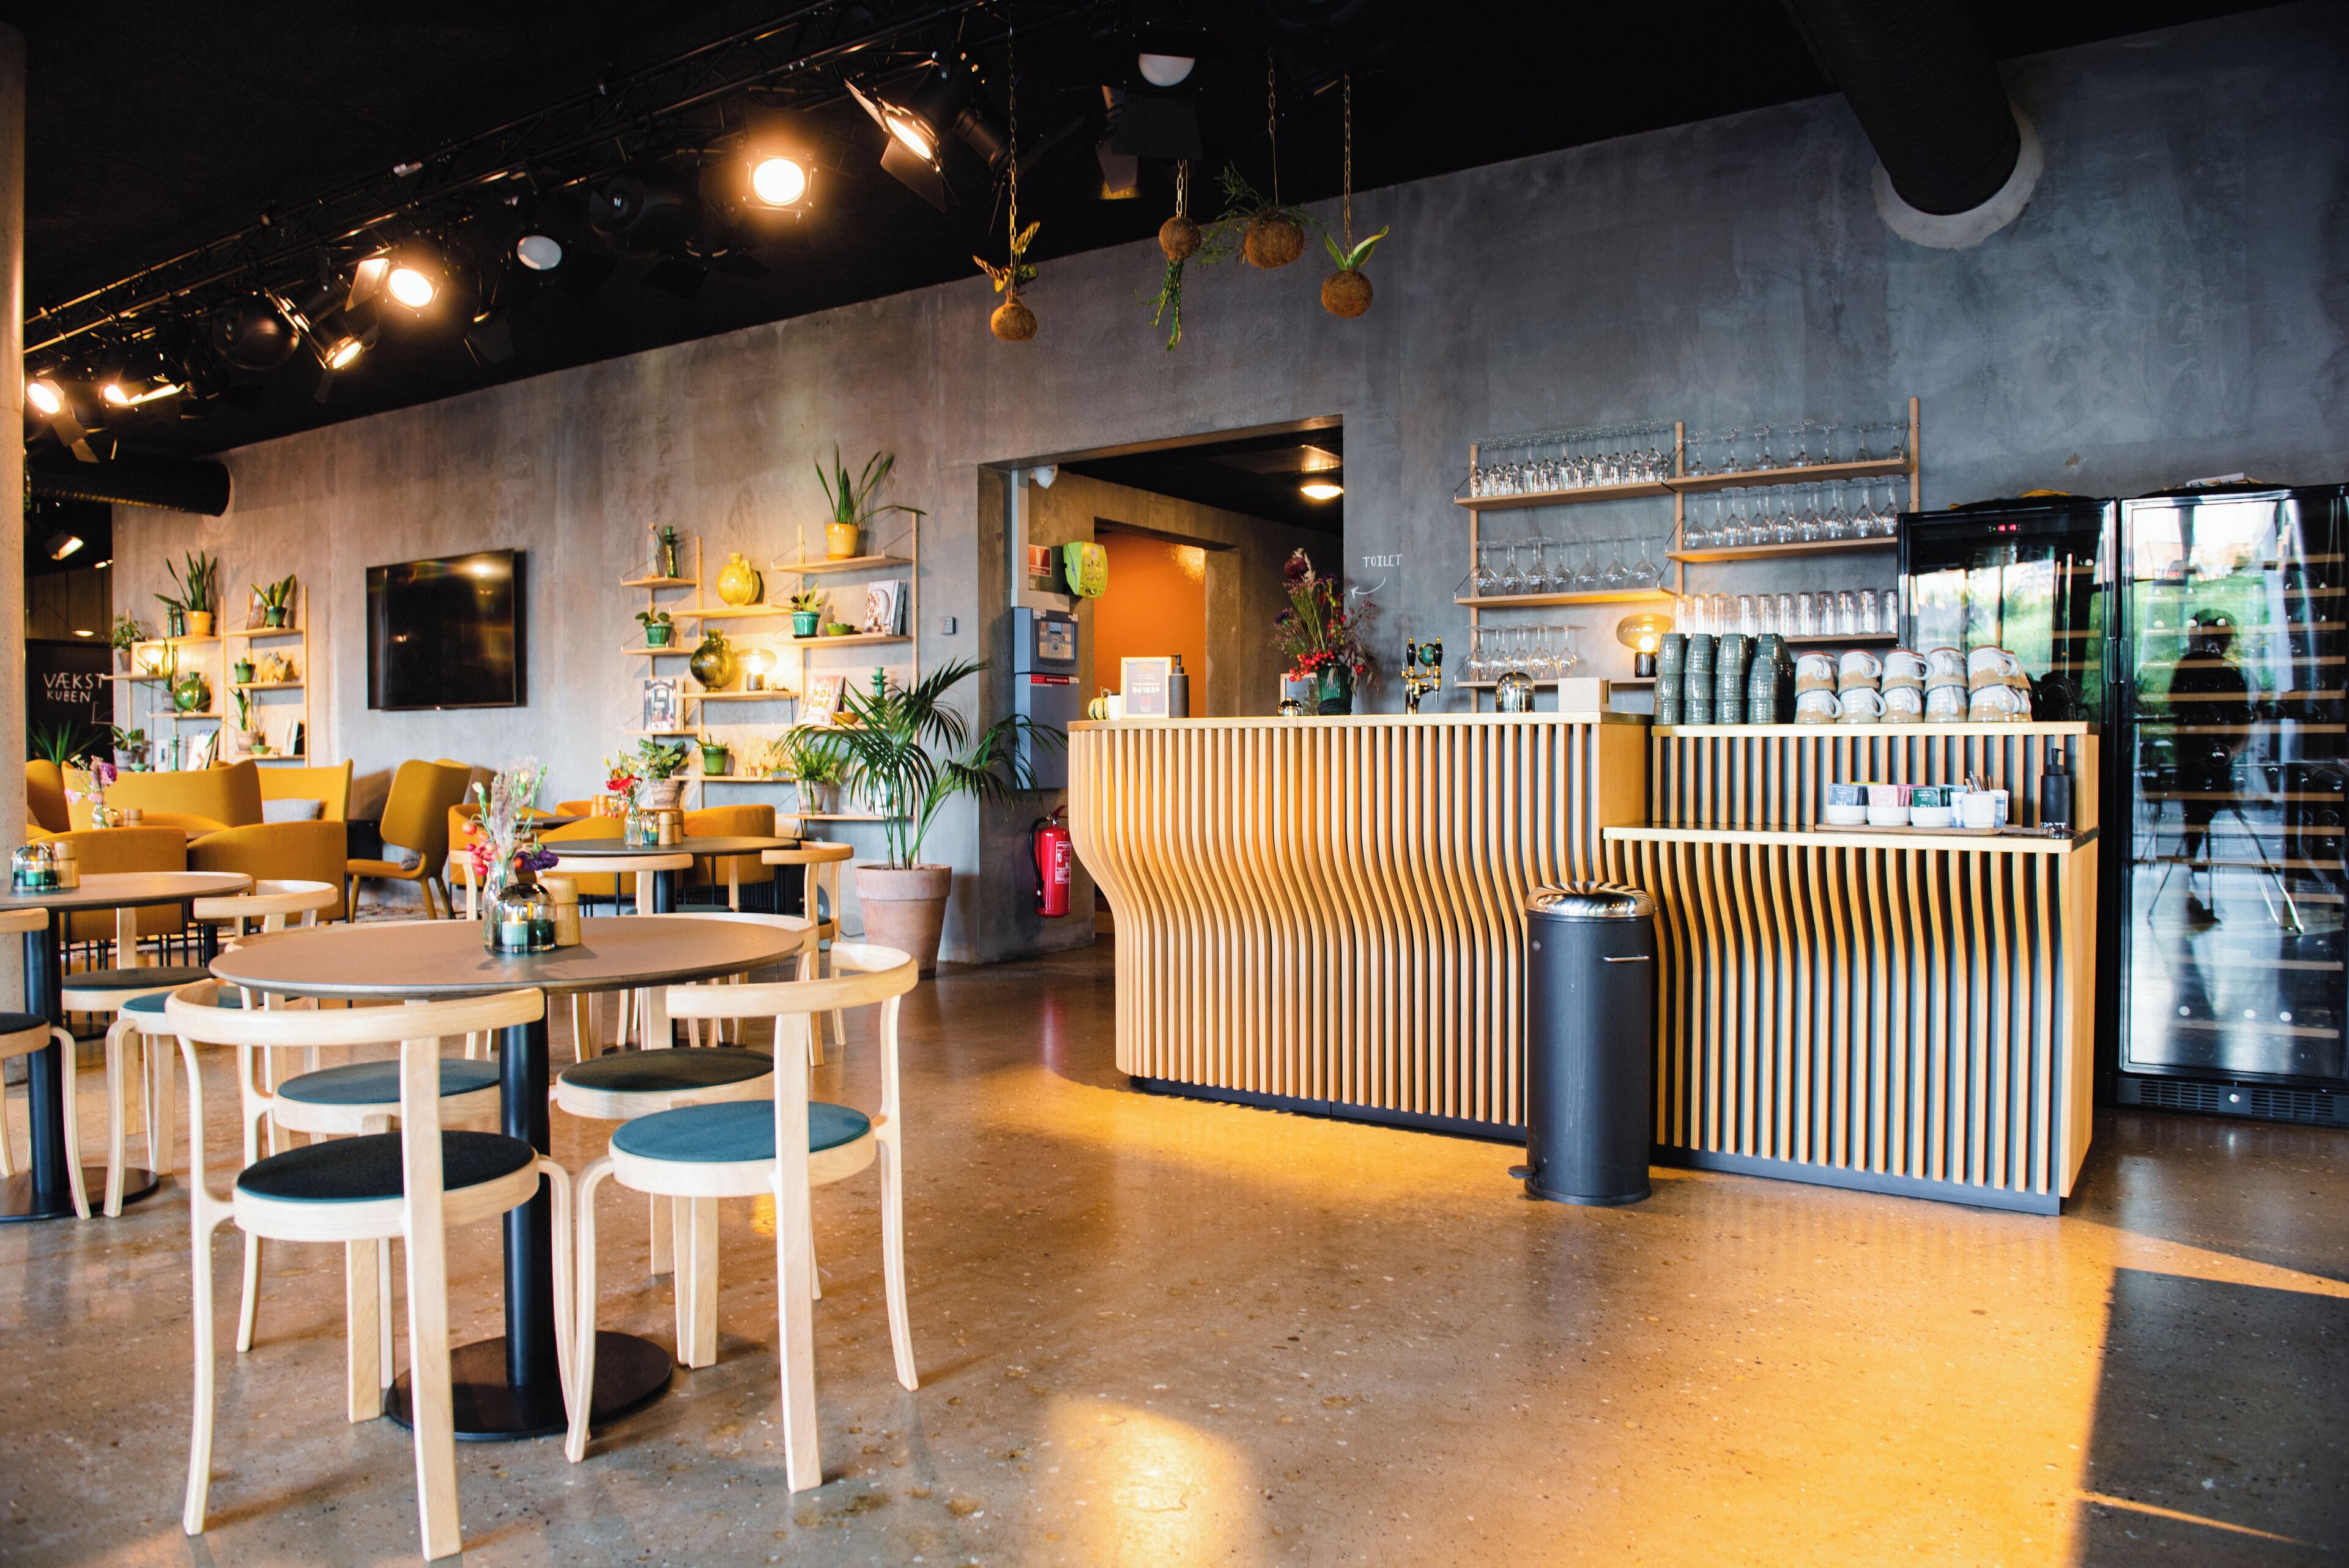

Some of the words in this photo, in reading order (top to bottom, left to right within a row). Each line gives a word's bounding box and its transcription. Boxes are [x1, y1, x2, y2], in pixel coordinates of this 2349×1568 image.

[1362, 554, 1403, 568] TOILET
[43, 673, 102, 689] VÆKST
[47, 689, 91, 703] KUBEN
